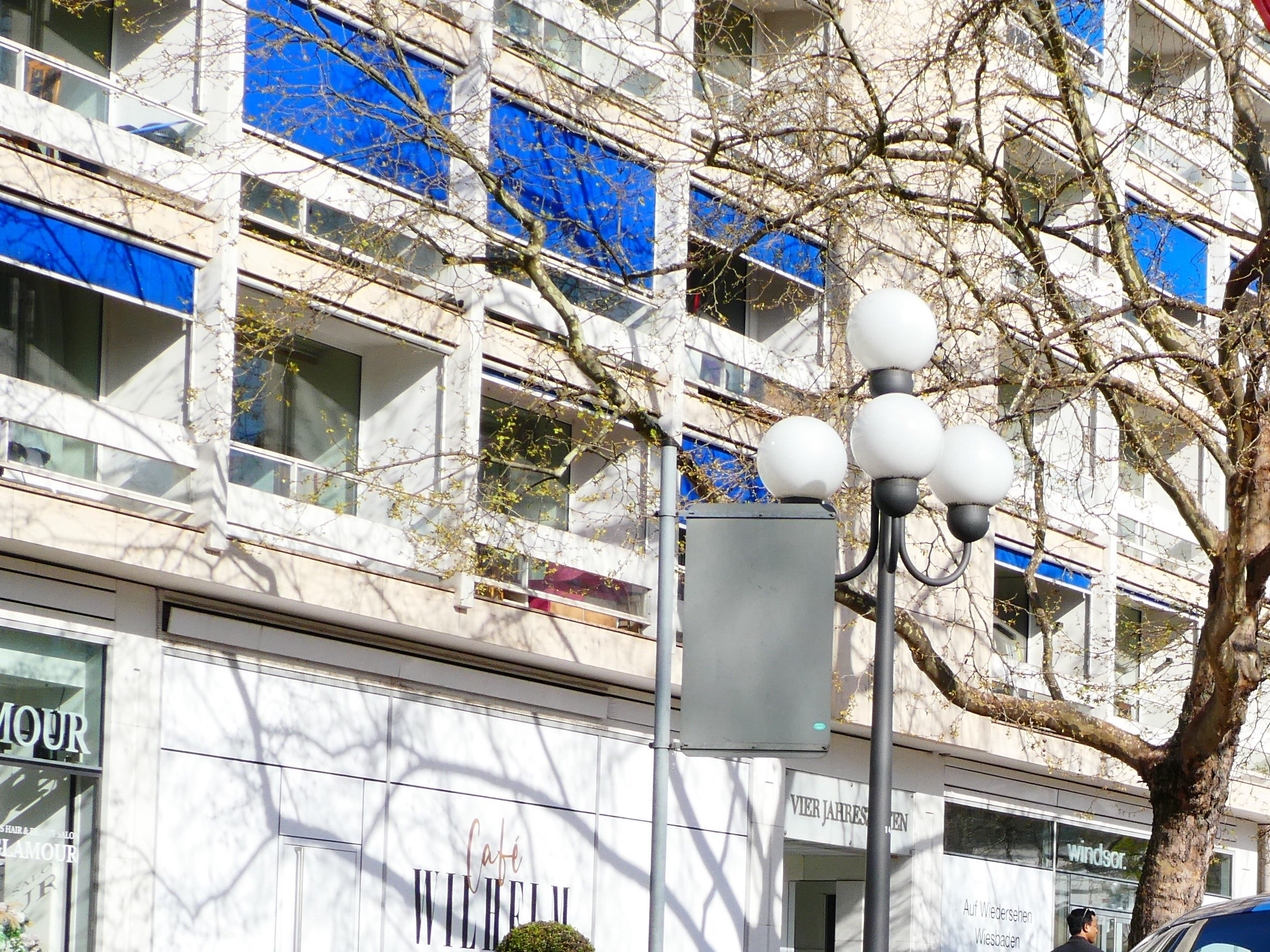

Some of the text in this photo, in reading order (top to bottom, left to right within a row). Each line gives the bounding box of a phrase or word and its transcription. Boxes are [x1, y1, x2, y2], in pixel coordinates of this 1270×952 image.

[790, 794, 908, 832] VIER JAHRESEN
[5, 824, 22, 834] HAIR
[30, 828, 56, 837] BETY
[0, 838, 77, 863] LAMOUR
[467, 818, 522, 894] Café
[1067, 840, 1127, 870] windsor.
[963, 899, 1032, 924] Auf Wiedersehen
[975, 927, 1020, 949] Wiesbaden
